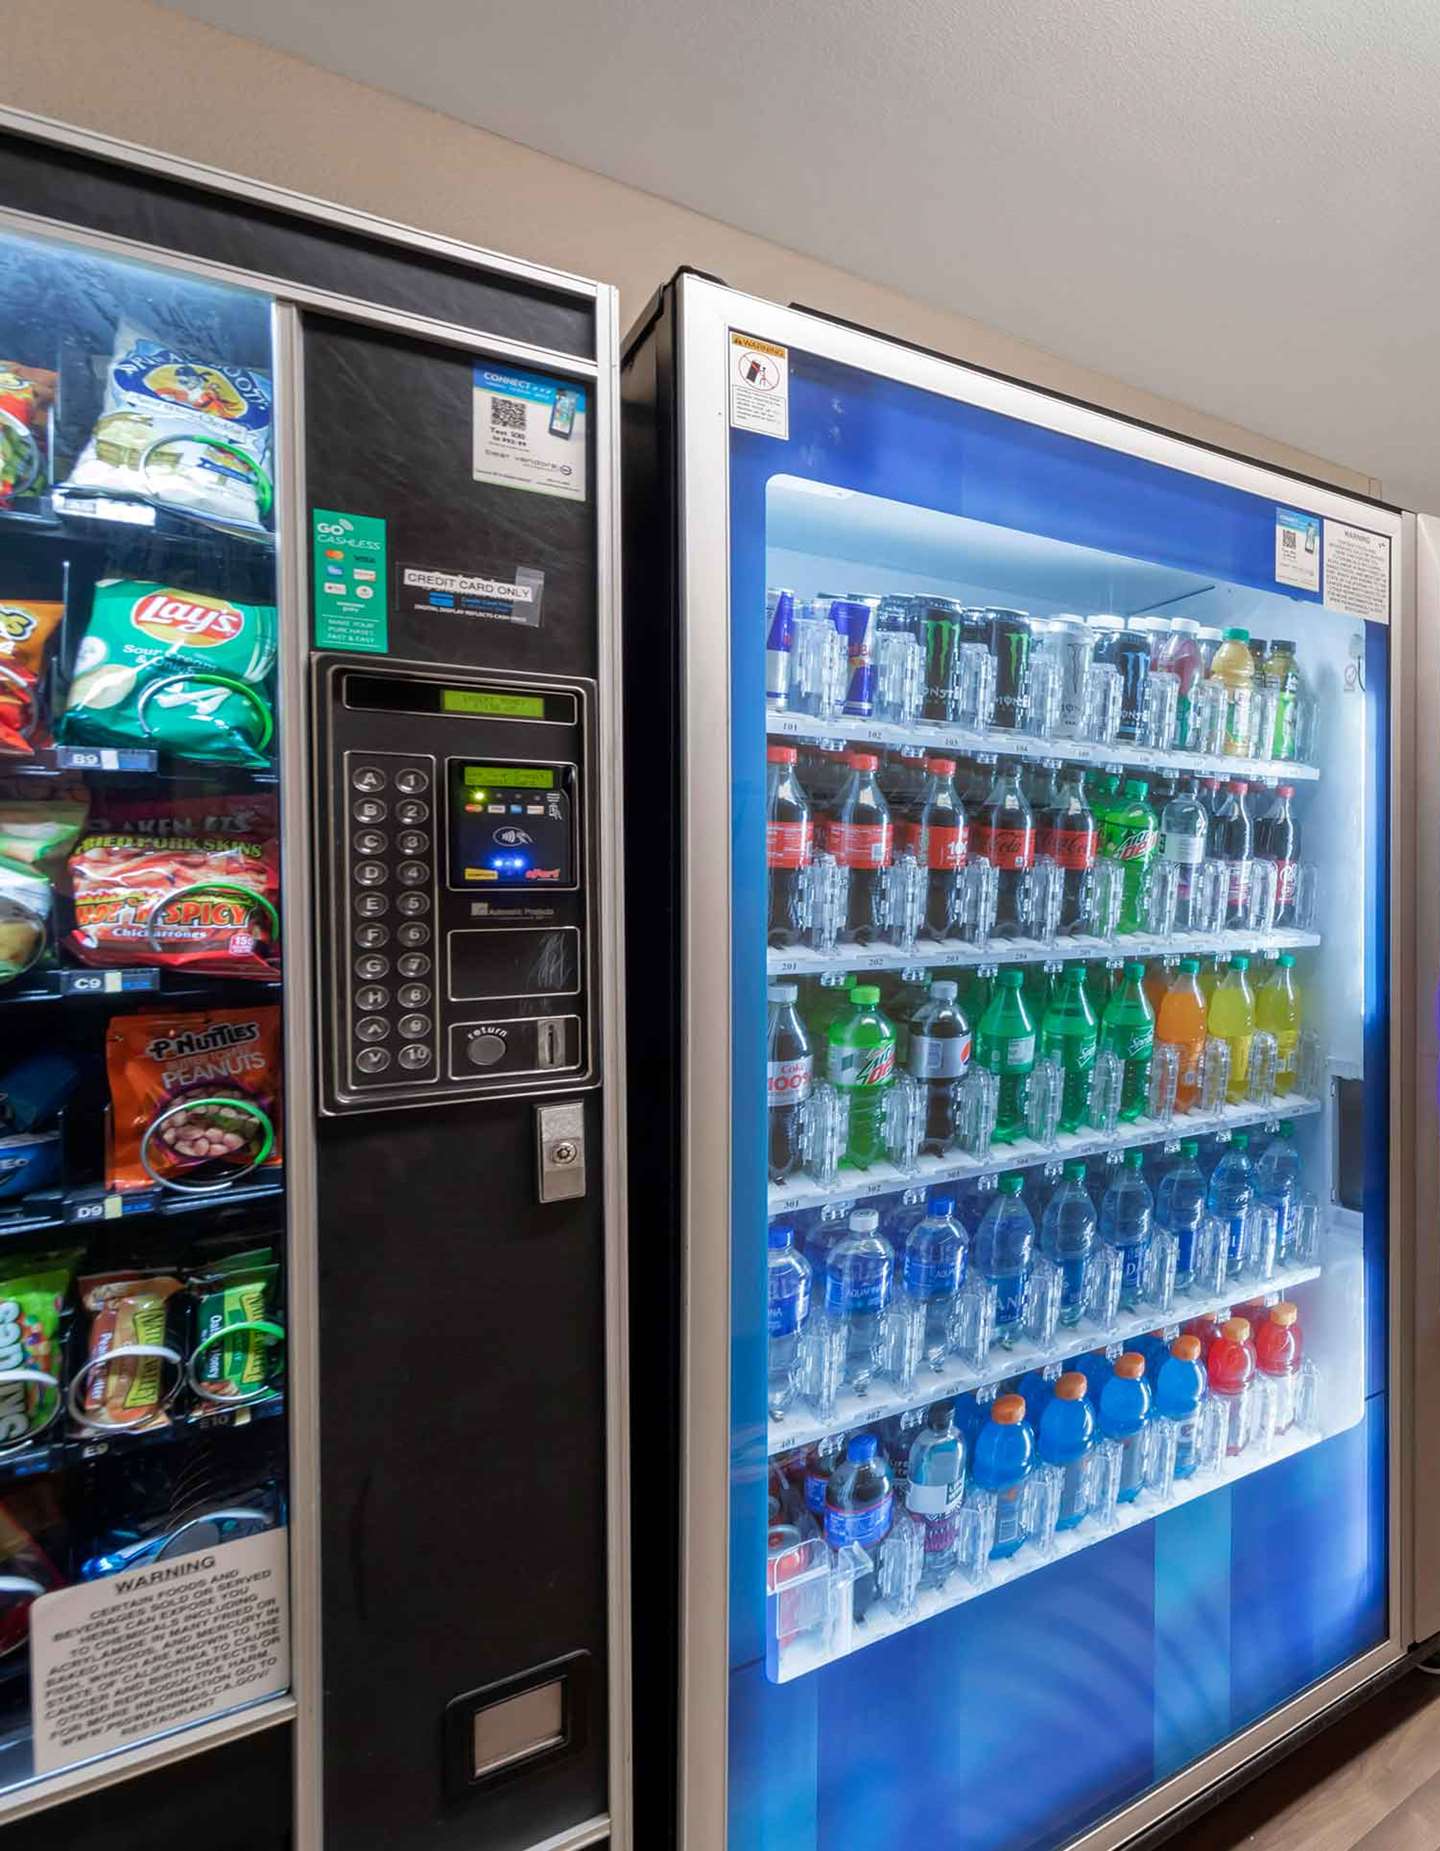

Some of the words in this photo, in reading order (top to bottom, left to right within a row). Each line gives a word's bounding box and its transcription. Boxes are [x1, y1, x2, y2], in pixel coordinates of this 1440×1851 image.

[317, 523, 344, 535] GO
[317, 534, 381, 550] CASHLESS
[407, 572, 455, 588] CREDIT
[458, 579, 493, 593] CARD
[497, 585, 529, 598] ONLY
[139, 596, 236, 634] Lay's
[122, 644, 162, 655] Sour
[73, 754, 98, 765] B9
[365, 774, 378, 784] A
[407, 775, 416, 785] 1
[364, 804, 378, 815] B
[408, 806, 418, 816] 2
[202, 839, 262, 859] SKINS
[365, 836, 378, 847] C
[408, 837, 418, 847] 3
[365, 867, 378, 878] D
[408, 867, 418, 878] 4
[165, 901, 248, 925] SPICY
[366, 898, 378, 909] E
[409, 898, 419, 909] 5
[367, 929, 379, 940] F
[409, 928, 420, 940] 6
[366, 960, 381, 972] G
[410, 959, 420, 969] 7
[74, 977, 101, 989] C9
[368, 991, 382, 1003] H
[410, 988, 421, 1000] 8
[409, 1020, 420, 1031] 9
[468, 1026, 508, 1040] return
[407, 1049, 426, 1060] 10
[162, 1051, 266, 1089] PEANUTS
[77, 1206, 103, 1218] D9
[115, 1556, 215, 1594] WARNING
[89, 1595, 153, 1619] CERTAIN
[158, 1579, 205, 1598] FOODS
[210, 1570, 238, 1583] AND
[53, 1608, 144, 1641] BEVERAGES
[150, 1595, 188, 1611] SOLD
[193, 1588, 212, 1598] OR
[217, 1570, 271, 1591] SERVED
[80, 1627, 119, 1642] HERE
[125, 1616, 155, 1629] CAN
[160, 1598, 214, 1618] EXPOSE
[221, 1587, 248, 1600] YOU
[70, 1646, 88, 1656] TO
[94, 1619, 178, 1649] CHEMICALS
[184, 1594, 257, 1621] INCLUDING
[49, 1640, 143, 1674] ACRYLAMIDE
[151, 1633, 165, 1642] IN
[170, 1620, 207, 1636] MANY
[213, 1606, 252, 1623] FRIED
[256, 1598, 275, 1609] OR
[45, 1665, 98, 1686] BAKED
[162, 1635, 191, 1649] AND
[197, 1612, 261, 1638] MERCURY
[266, 1607, 279, 1616] IN
[89, 1663, 137, 1682] WHICH
[142, 1653, 168, 1665] ARE
[175, 1634, 227, 1655] KNOWN
[233, 1627, 249, 1636] TO
[255, 1617, 279, 1629] THE
[45, 1687, 91, 1707] STATE
[97, 1679, 115, 1690] OF
[122, 1650, 207, 1682] CALIFORNIA
[213, 1643, 230, 1653] TO
[234, 1627, 279, 1646] CAUSE
[45, 1692, 109, 1718] CANCER
[114, 1681, 143, 1695] AND
[149, 1666, 191, 1684] BIRTH
[195, 1644, 257, 1669] DEFECTS
[262, 1637, 280, 1647] OR
[48, 1723, 81, 1739] FOR
[87, 1707, 128, 1726] MORE
[135, 1673, 230, 1710] INFORMATION
[236, 1664, 254, 1676] GO
[260, 1657, 277, 1668] TO
[56, 1703, 108, 1726] OTHER
[113, 1665, 223, 1707] REPRODUCTIVE
[121, 1698, 214, 1734] RESTAURANT
